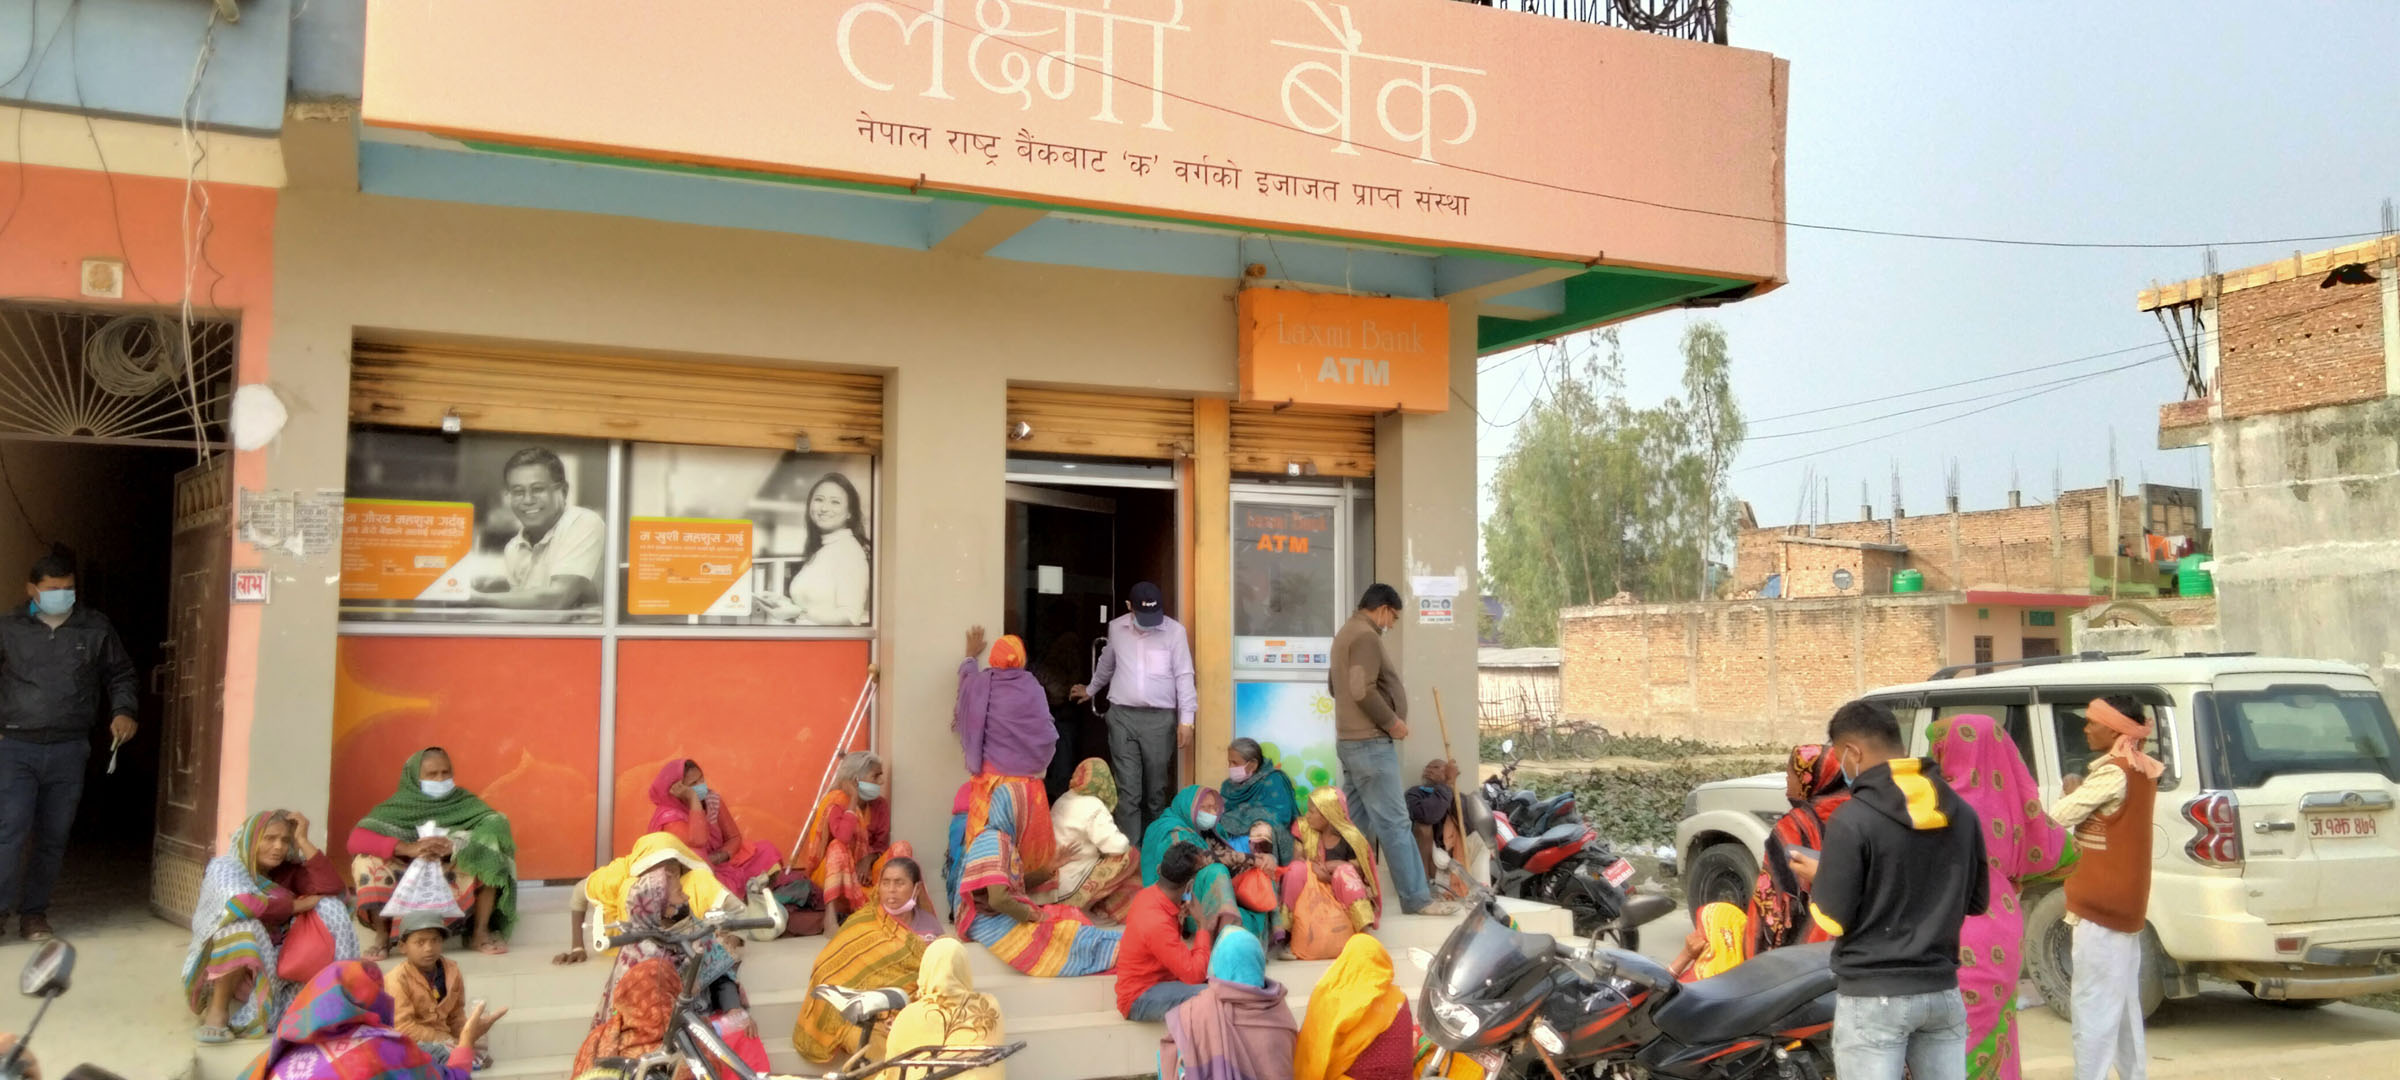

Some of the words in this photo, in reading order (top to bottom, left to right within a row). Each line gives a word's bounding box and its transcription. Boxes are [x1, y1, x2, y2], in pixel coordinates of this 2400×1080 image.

[1270, 0, 1487, 165] बैंक
[856, 110, 932, 150] नेपाल
[946, 129, 1001, 166] राष्ट्र
[1015, 128, 1108, 173] बैंकबाट
[1173, 154, 1243, 190] वर्गको
[1254, 170, 1341, 203] इजाजत
[1352, 183, 1403, 209] प्राप्त
[1414, 186, 1471, 217] संस्था
[1277, 312, 1353, 349] Laxmi
[1361, 320, 1425, 353] Bank
[1317, 356, 1391, 387] ATM
[1256, 533, 1309, 553] ATM
